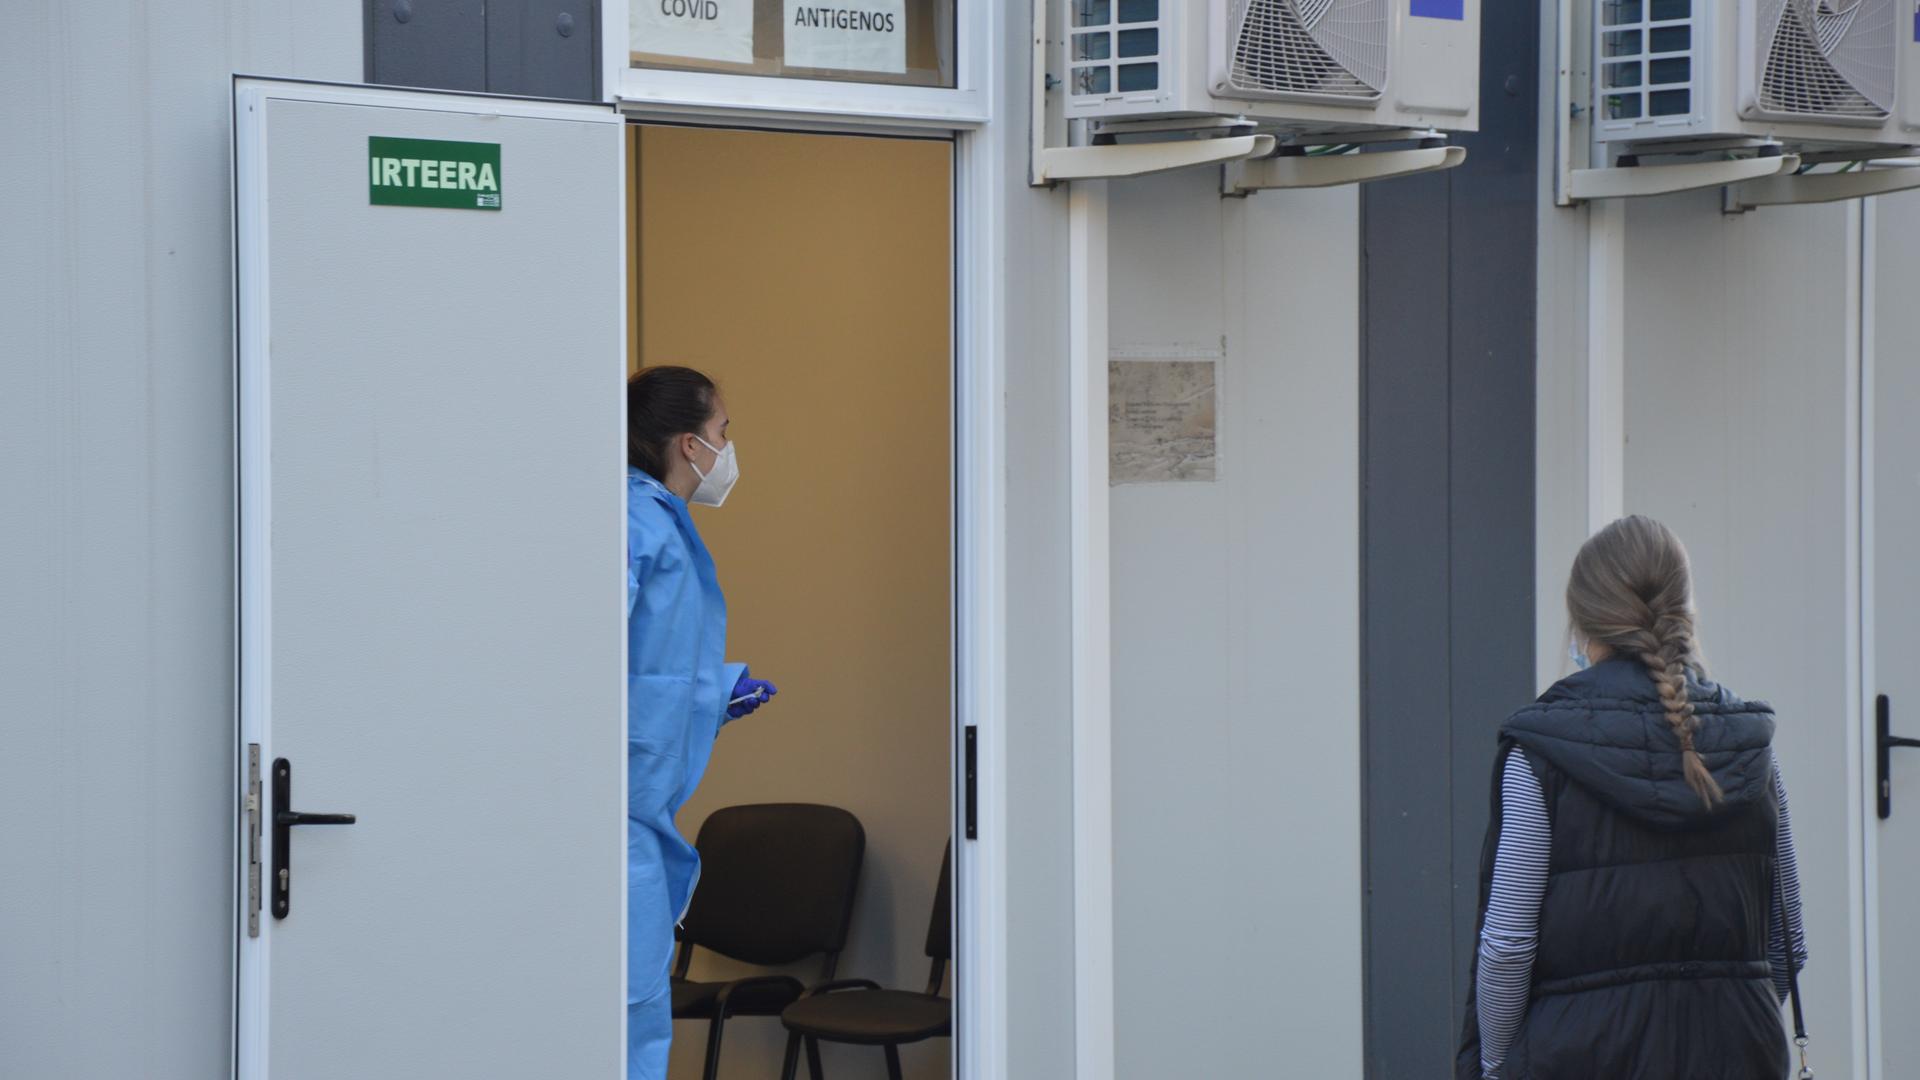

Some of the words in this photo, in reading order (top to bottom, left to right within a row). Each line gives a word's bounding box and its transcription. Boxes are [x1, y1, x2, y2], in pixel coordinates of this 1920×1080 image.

[661, 0, 718, 20] COVID
[795, 6, 894, 33] ANTIGENOS
[372, 157, 498, 191] IRTEERA
